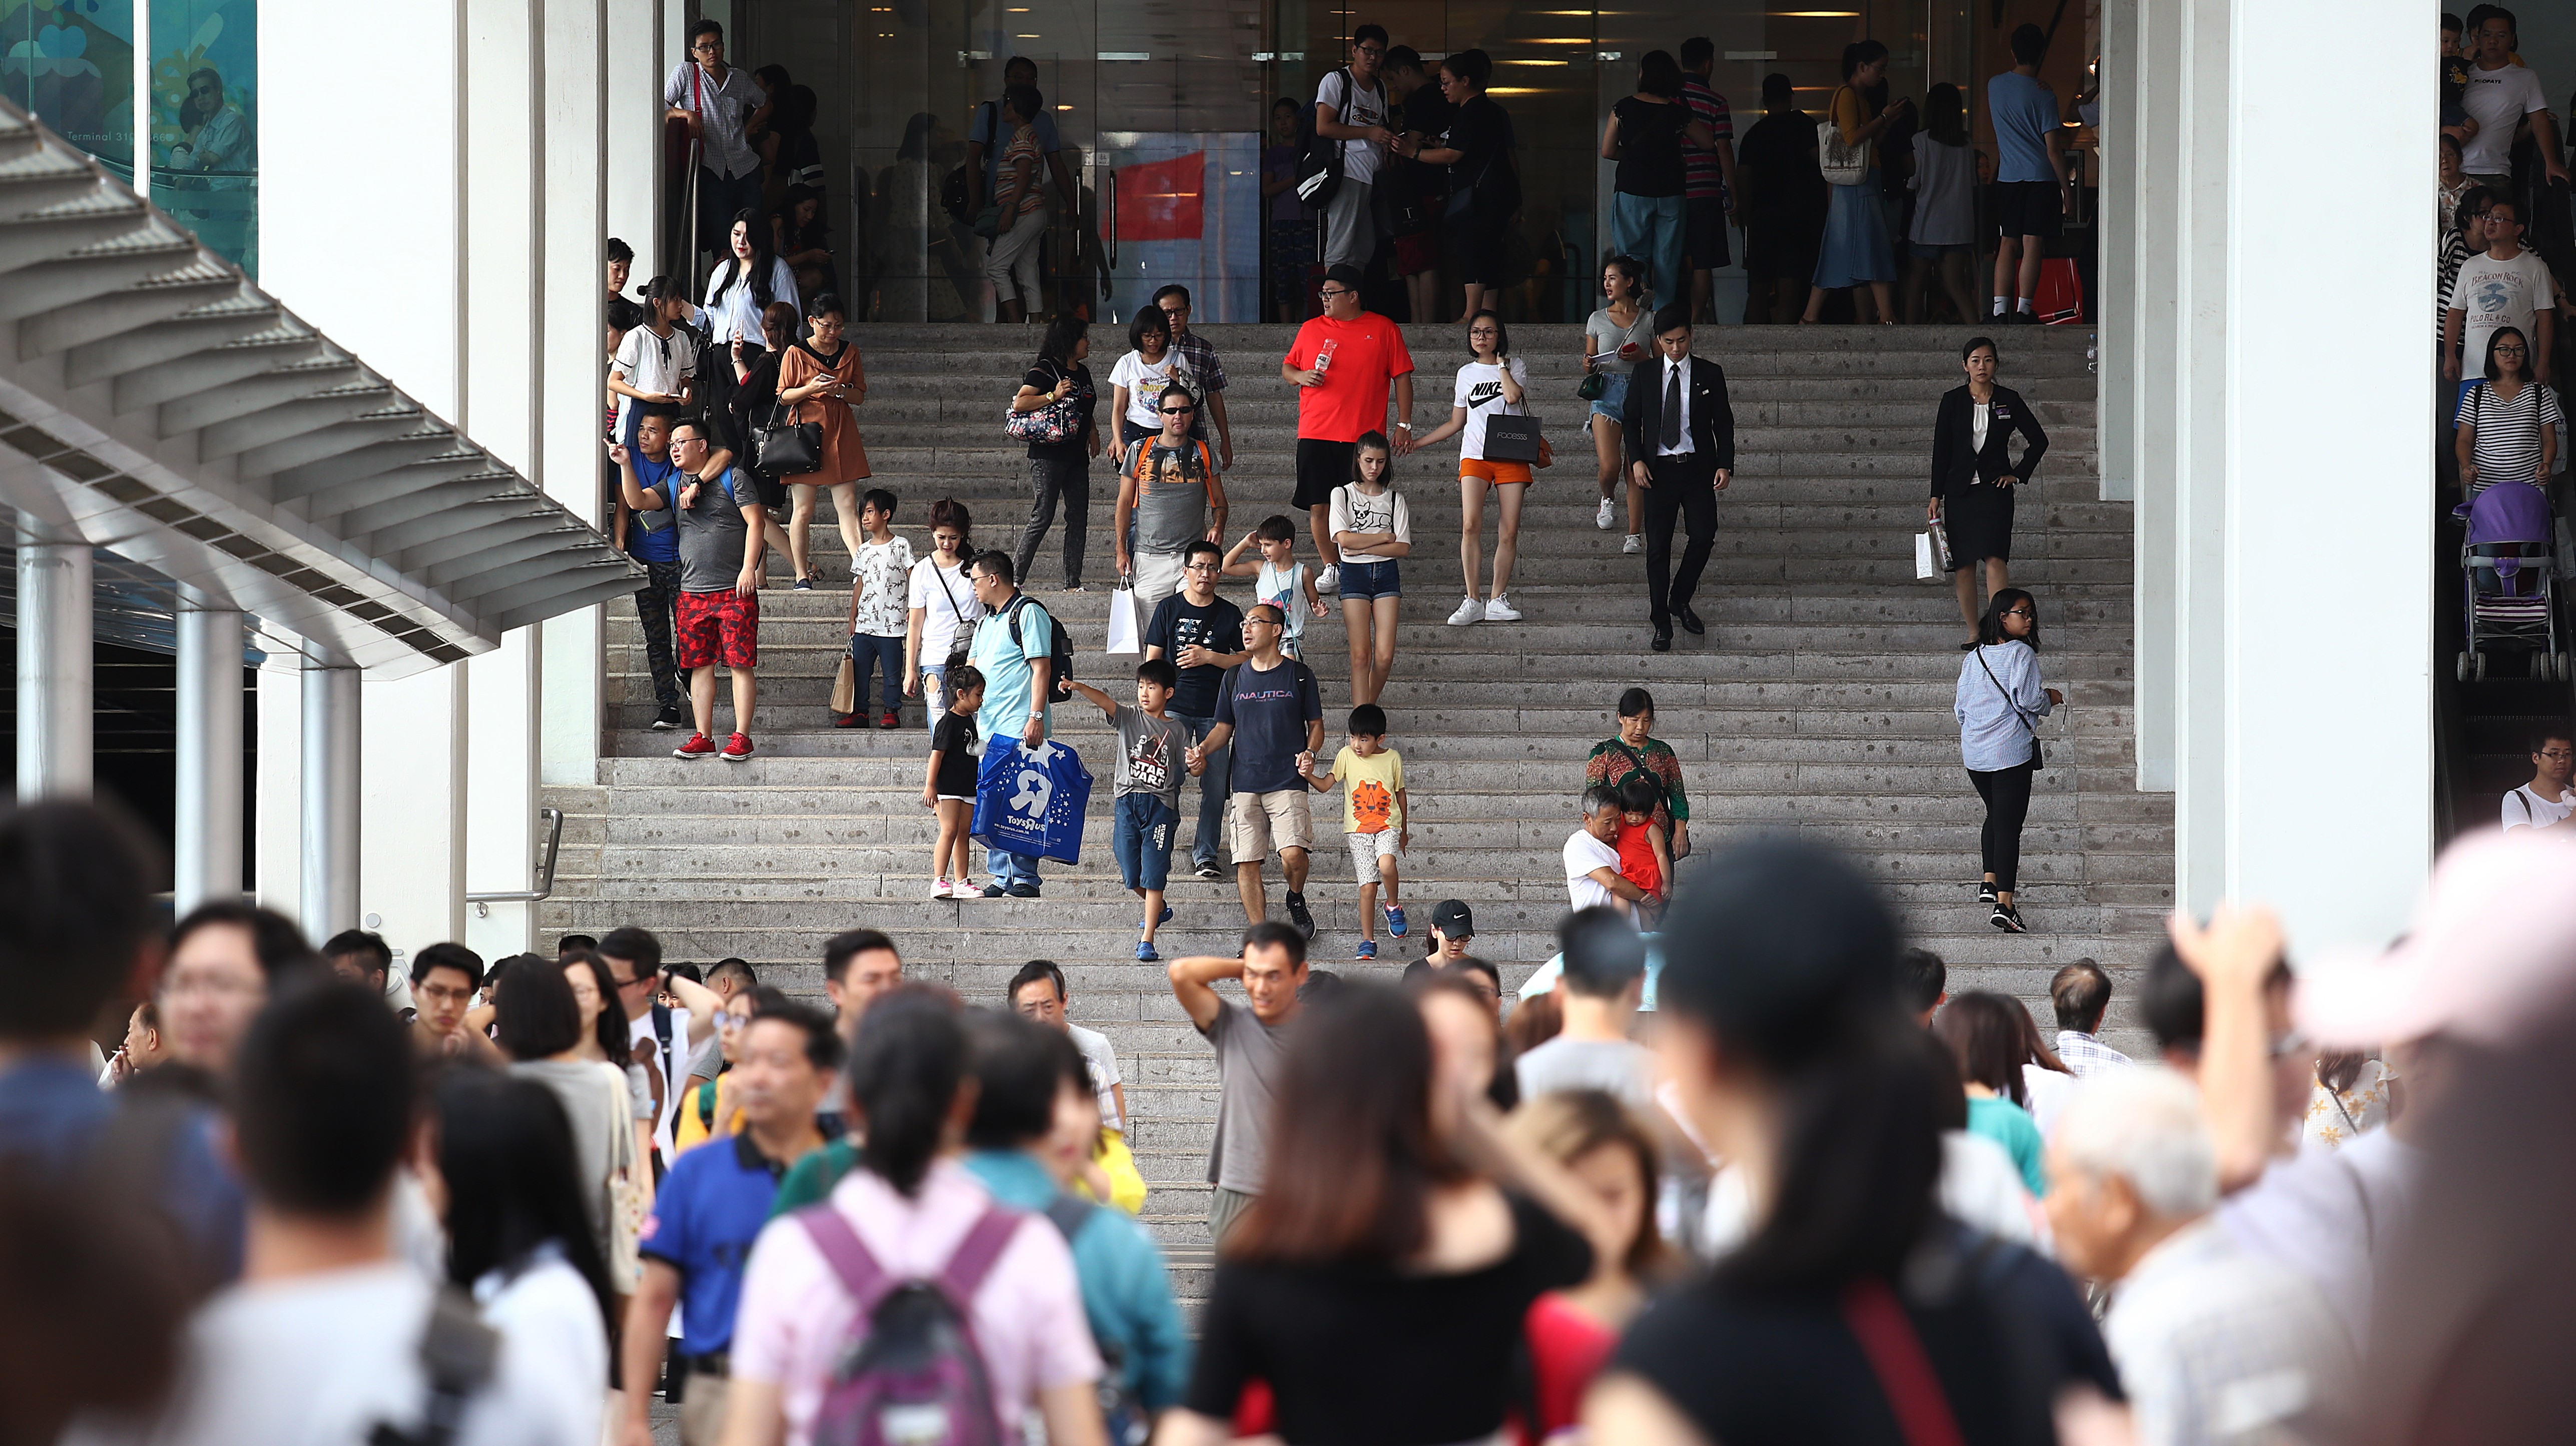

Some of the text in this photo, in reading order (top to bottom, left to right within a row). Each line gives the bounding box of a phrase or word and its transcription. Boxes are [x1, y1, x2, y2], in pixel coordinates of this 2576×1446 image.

[68, 131, 112, 141] Terminal
[2471, 273, 2502, 287] BEACON
[2503, 272, 2523, 288] ROCK
[2470, 314, 2483, 323] POLO
[2484, 313, 2494, 322] RL
[2501, 314, 2511, 324] CO
[1143, 384, 1165, 392] ROXY
[1470, 381, 1503, 397] NIKE
[1144, 398, 1159, 406] LOV
[1239, 689, 1294, 700] NAUTICA
[1130, 761, 1166, 779] STAR
[1130, 766, 1165, 787] WARS
